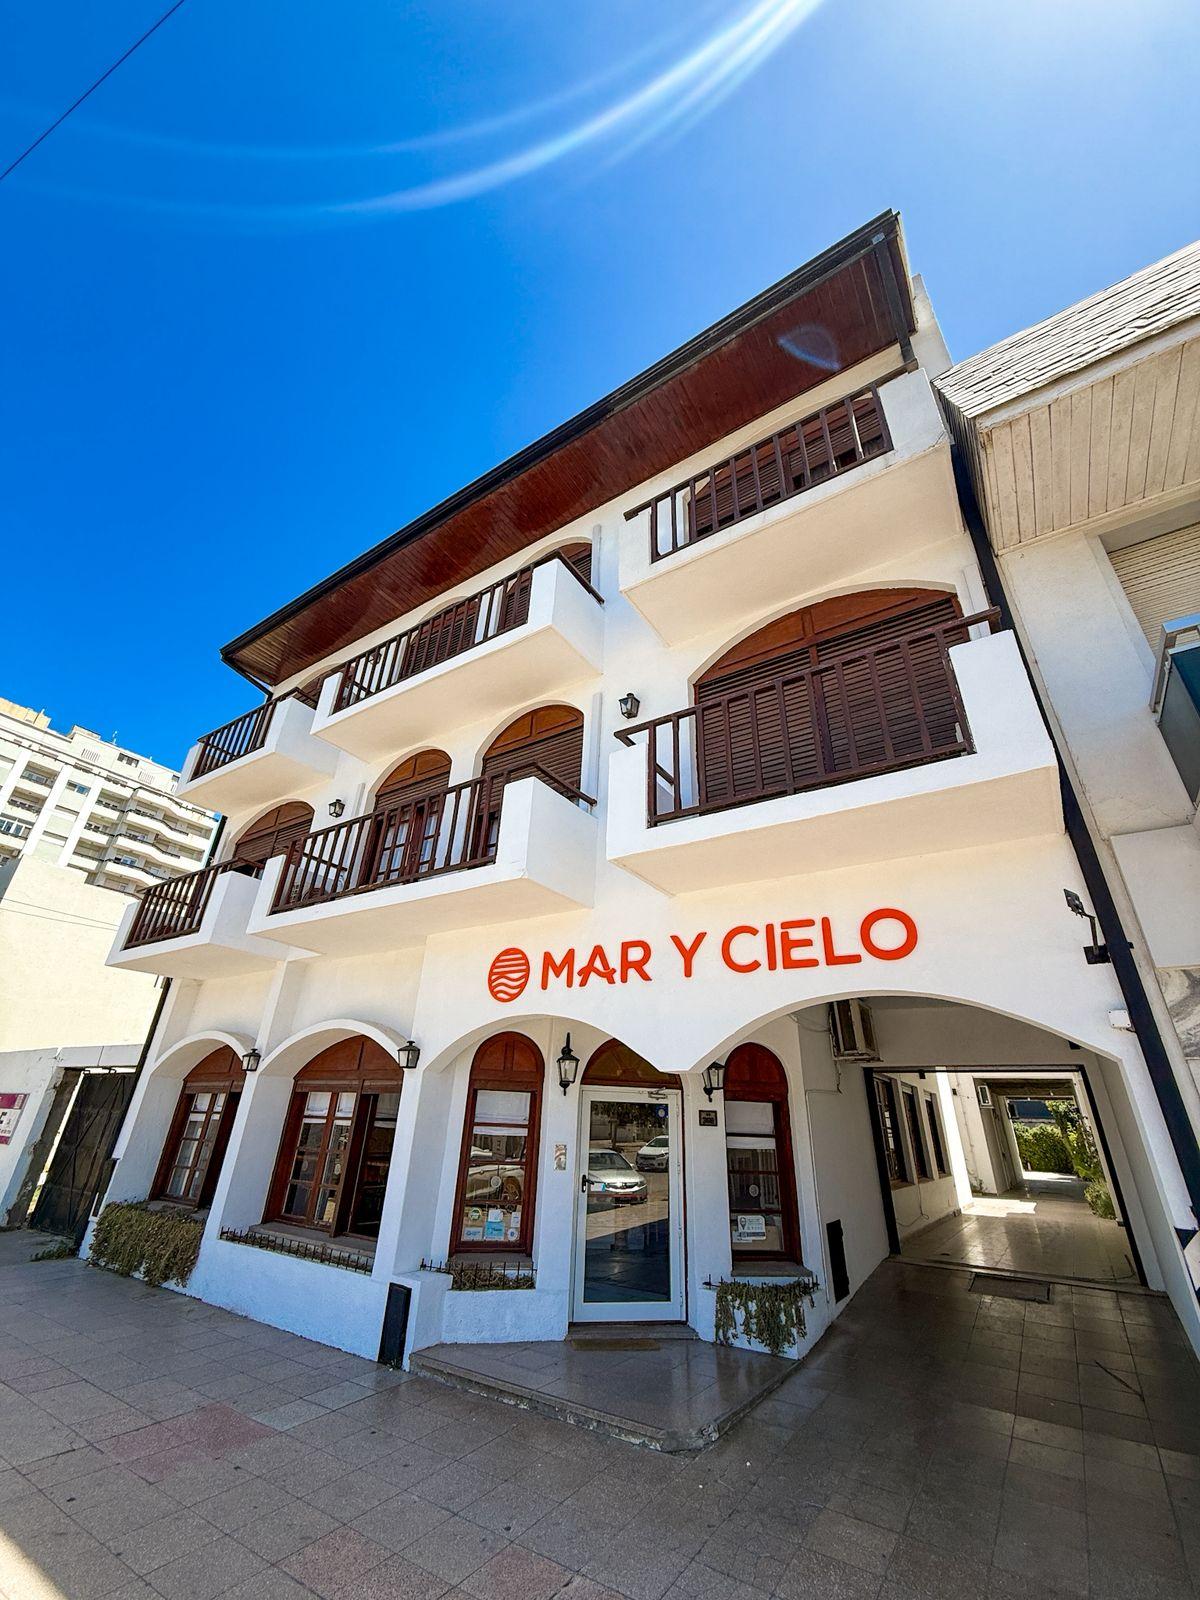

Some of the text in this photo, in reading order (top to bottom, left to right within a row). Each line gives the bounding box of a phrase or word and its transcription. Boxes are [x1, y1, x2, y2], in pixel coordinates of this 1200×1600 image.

[541, 907, 919, 990] MAR Y CIELO
